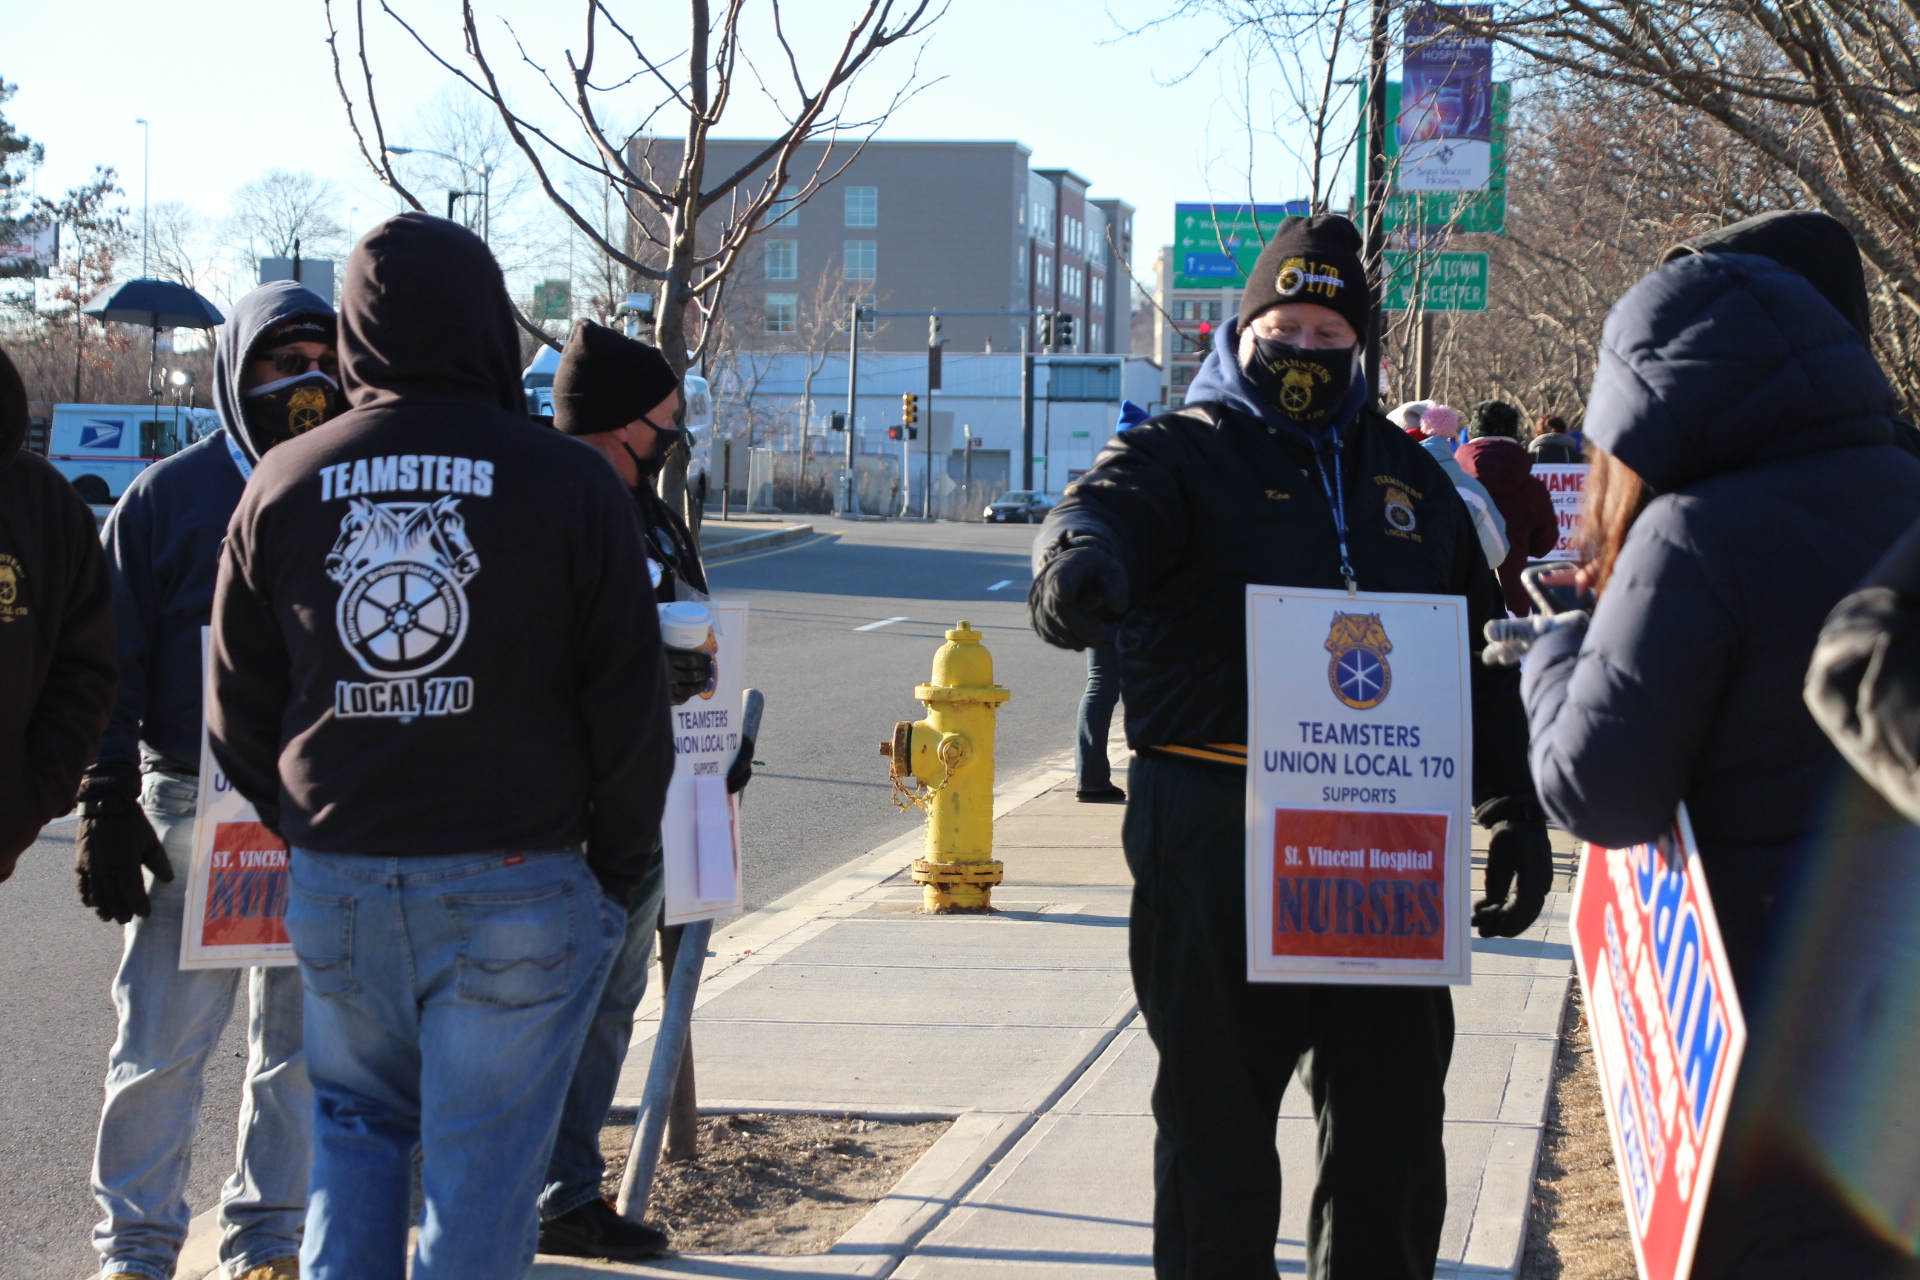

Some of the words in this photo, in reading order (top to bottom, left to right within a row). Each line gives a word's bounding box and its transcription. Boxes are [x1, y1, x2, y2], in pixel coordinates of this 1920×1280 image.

[1421, 51, 1472, 61] HOSPITAL
[1304, 272, 1345, 288] Teamsters
[1401, 285, 1481, 302] WRCESTER
[1267, 359, 1331, 384] TEAMSTERS
[319, 454, 495, 502] TEAMSTERS
[1374, 475, 1423, 499] TEAMSTERS
[1532, 473, 1586, 492] HAME
[1385, 528, 1409, 539] LOCAL
[1411, 532, 1422, 542] 170
[334, 678, 421, 718] LOCAL
[424, 675, 474, 715] 170
[677, 710, 728, 730] TEAMSTERS
[674, 735, 699, 754] NION
[700, 734, 724, 752] LOCAL
[726, 732, 737, 750] 170
[1298, 721, 1421, 748] TEAMSTERS
[693, 761, 719, 775] SUPPORTS
[1264, 750, 1339, 774] UNION
[1344, 753, 1412, 777] LOCAL
[1420, 756, 1455, 779] 170
[1322, 786, 1396, 804] SUPPORTS
[213, 851, 235, 868] ST.
[239, 850, 290, 868] VINCEN
[1284, 845, 1302, 867] St.
[1307, 846, 1365, 869] Vincent
[1369, 848, 1433, 871] Hospital
[1276, 875, 1441, 938] NURSES
